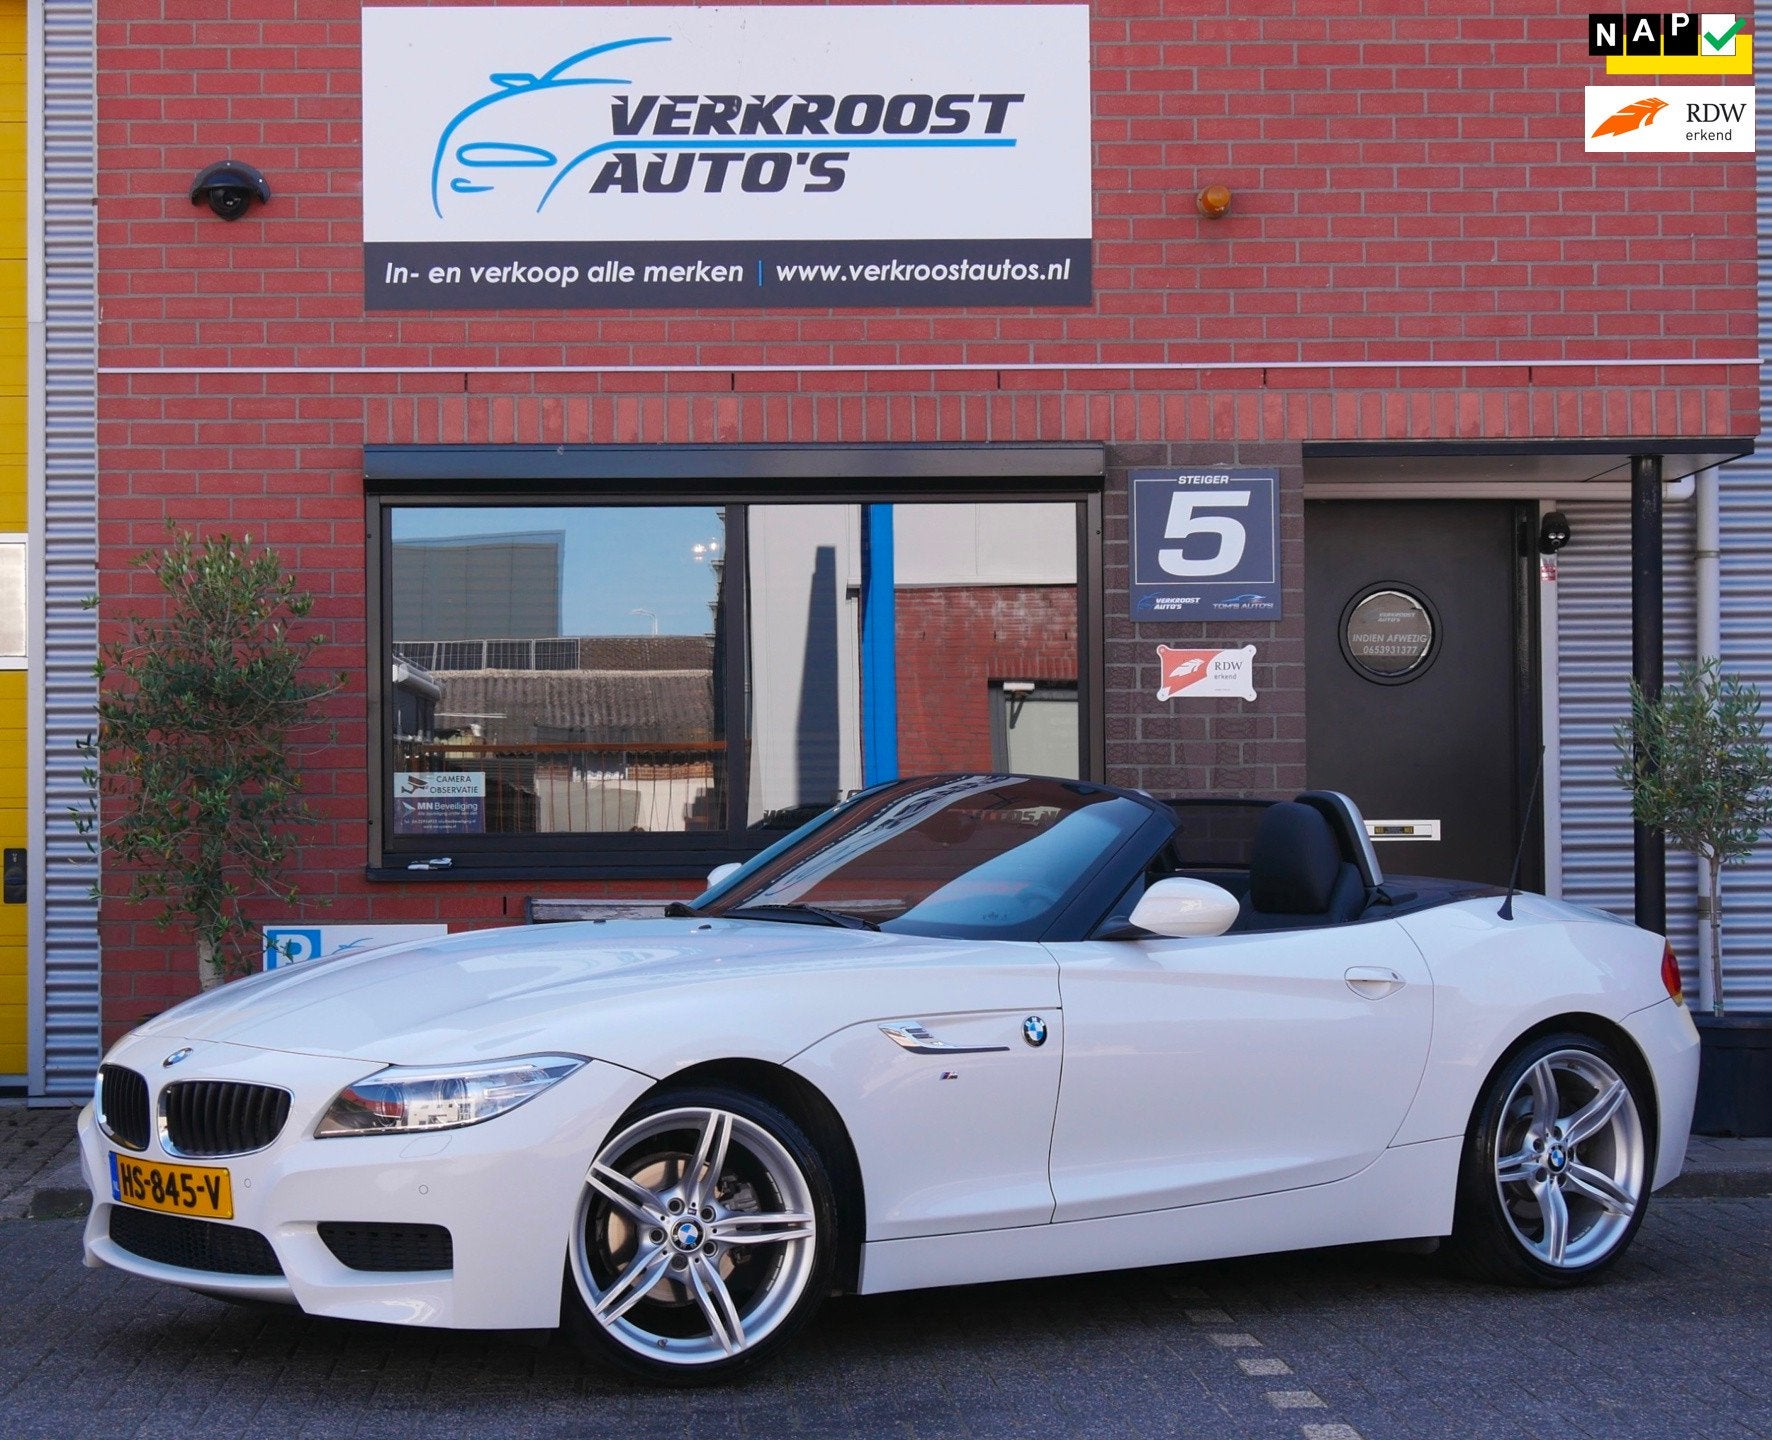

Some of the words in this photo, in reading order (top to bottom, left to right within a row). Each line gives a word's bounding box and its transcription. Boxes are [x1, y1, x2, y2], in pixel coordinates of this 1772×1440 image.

[611, 93, 1025, 135] VERKROOST
[588, 152, 850, 193] AUTO'S
[385, 262, 420, 284] In-
[428, 266, 461, 284] en
[470, 261, 579, 288] verkoop
[587, 260, 635, 283] alle
[643, 260, 744, 283] merken
[776, 258, 1071, 282] www.verkroostautos.nl
[1178, 475, 1229, 485] STEIGER
[1158, 491, 1251, 577] 5
[1352, 634, 1384, 642] INDIEN
[1386, 634, 1428, 643] AFWEZIG
[1363, 645, 1418, 654] 0653931377
[1214, 661, 1243, 671] RDW
[436, 775, 472, 783] CAMERA
[429, 786, 479, 794] OBSERVATIE
[417, 802, 433, 810] MN
[434, 802, 478, 812] Beveiliging
[120, 1162, 221, 1211] HS-845-V
